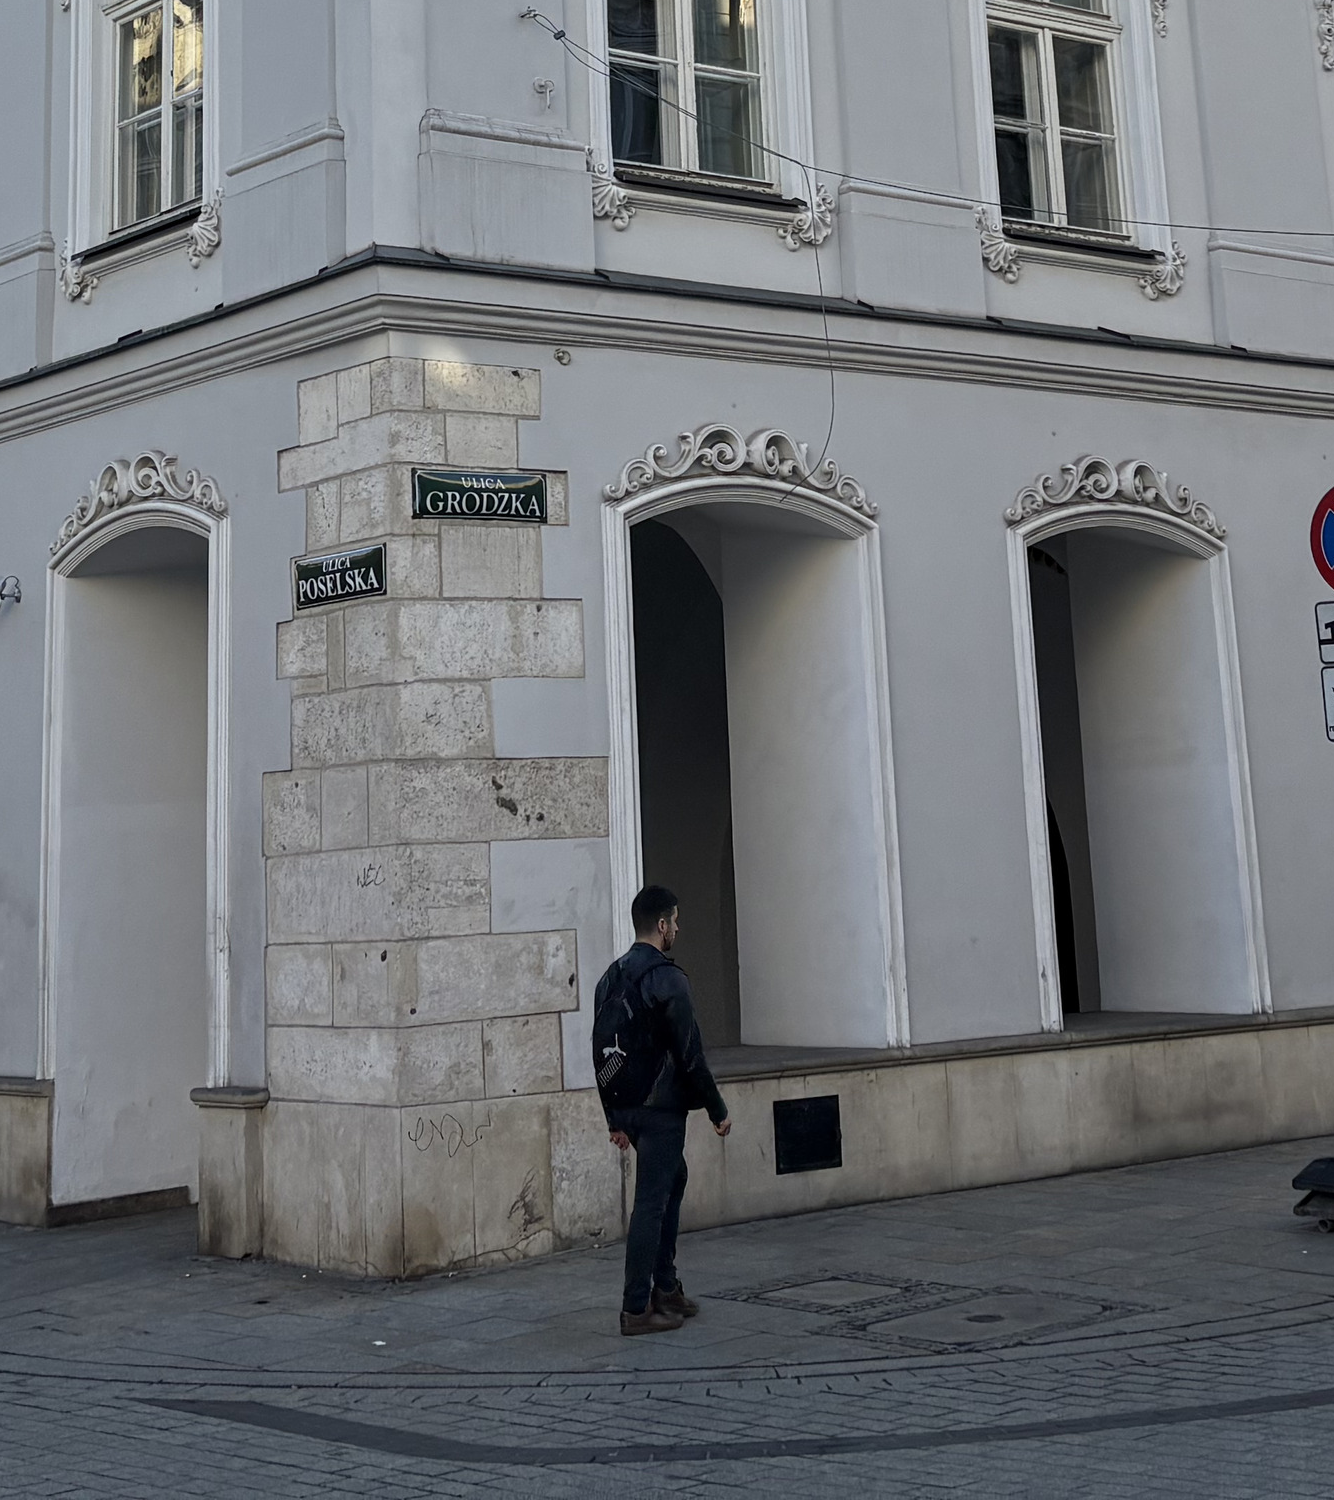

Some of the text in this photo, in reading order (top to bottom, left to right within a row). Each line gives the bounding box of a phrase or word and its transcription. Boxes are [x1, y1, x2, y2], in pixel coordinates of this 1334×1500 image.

[461, 477, 506, 490] ULICA
[425, 491, 542, 517] GRODZKA
[322, 557, 351, 572] ULICA
[298, 567, 380, 602] POSELSKA
